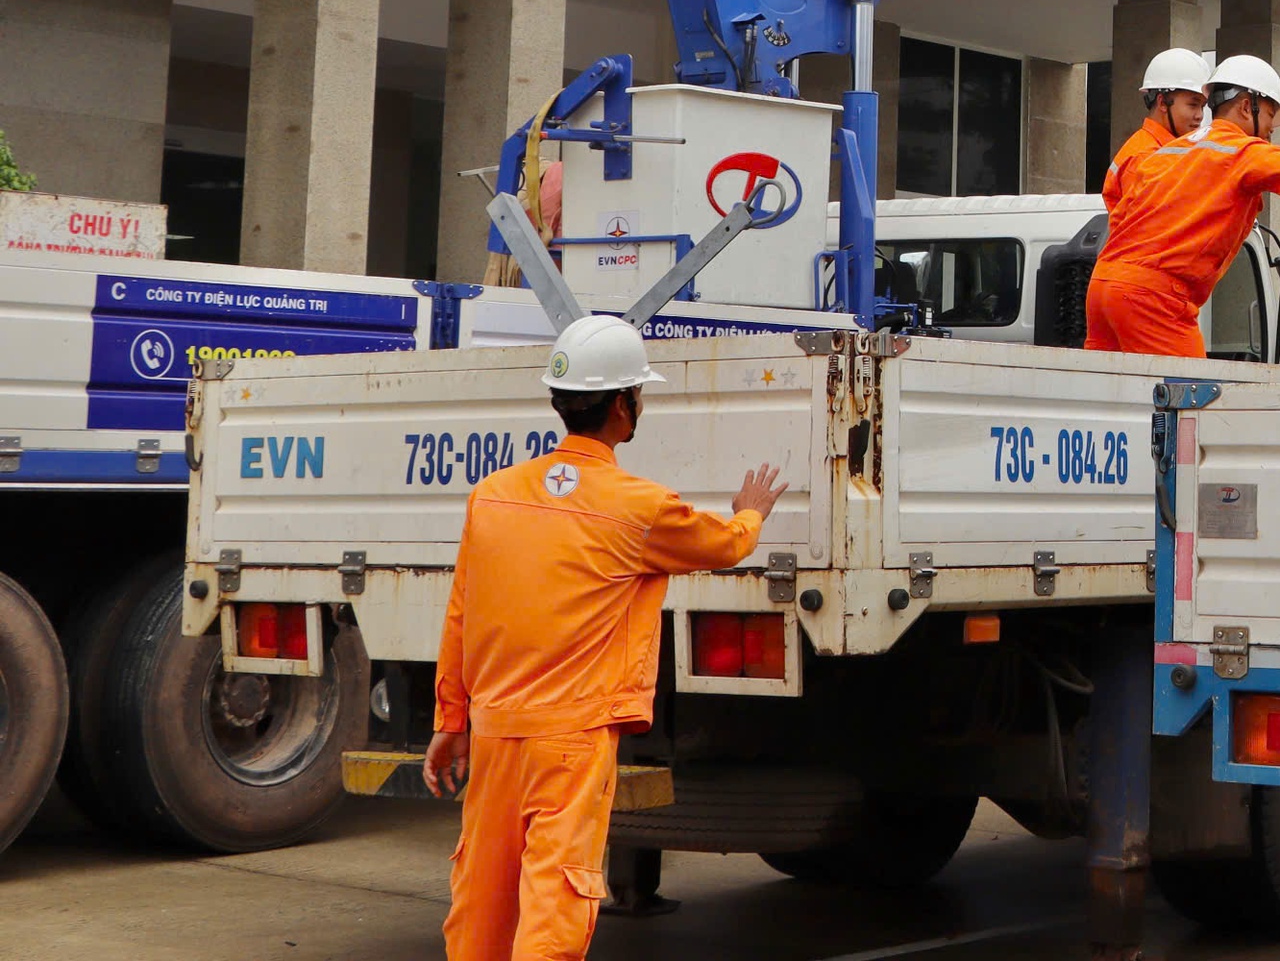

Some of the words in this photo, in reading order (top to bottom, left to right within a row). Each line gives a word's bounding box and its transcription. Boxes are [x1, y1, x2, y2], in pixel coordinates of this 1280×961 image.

[68, 211, 113, 237] CHÚ
[598, 255, 637, 266] EVNCPC
[146, 287, 183, 303] CÔNG
[185, 291, 201, 304] TY
[204, 290, 234, 308] ĐIỆN
[236, 294, 261, 310] LỰC
[263, 291, 306, 310] QUẢNG
[308, 300, 328, 313] TRỊ
[655, 320, 693, 338] CÔNG
[185, 345, 296, 365] 19001
[240, 435, 325, 479] EVN
